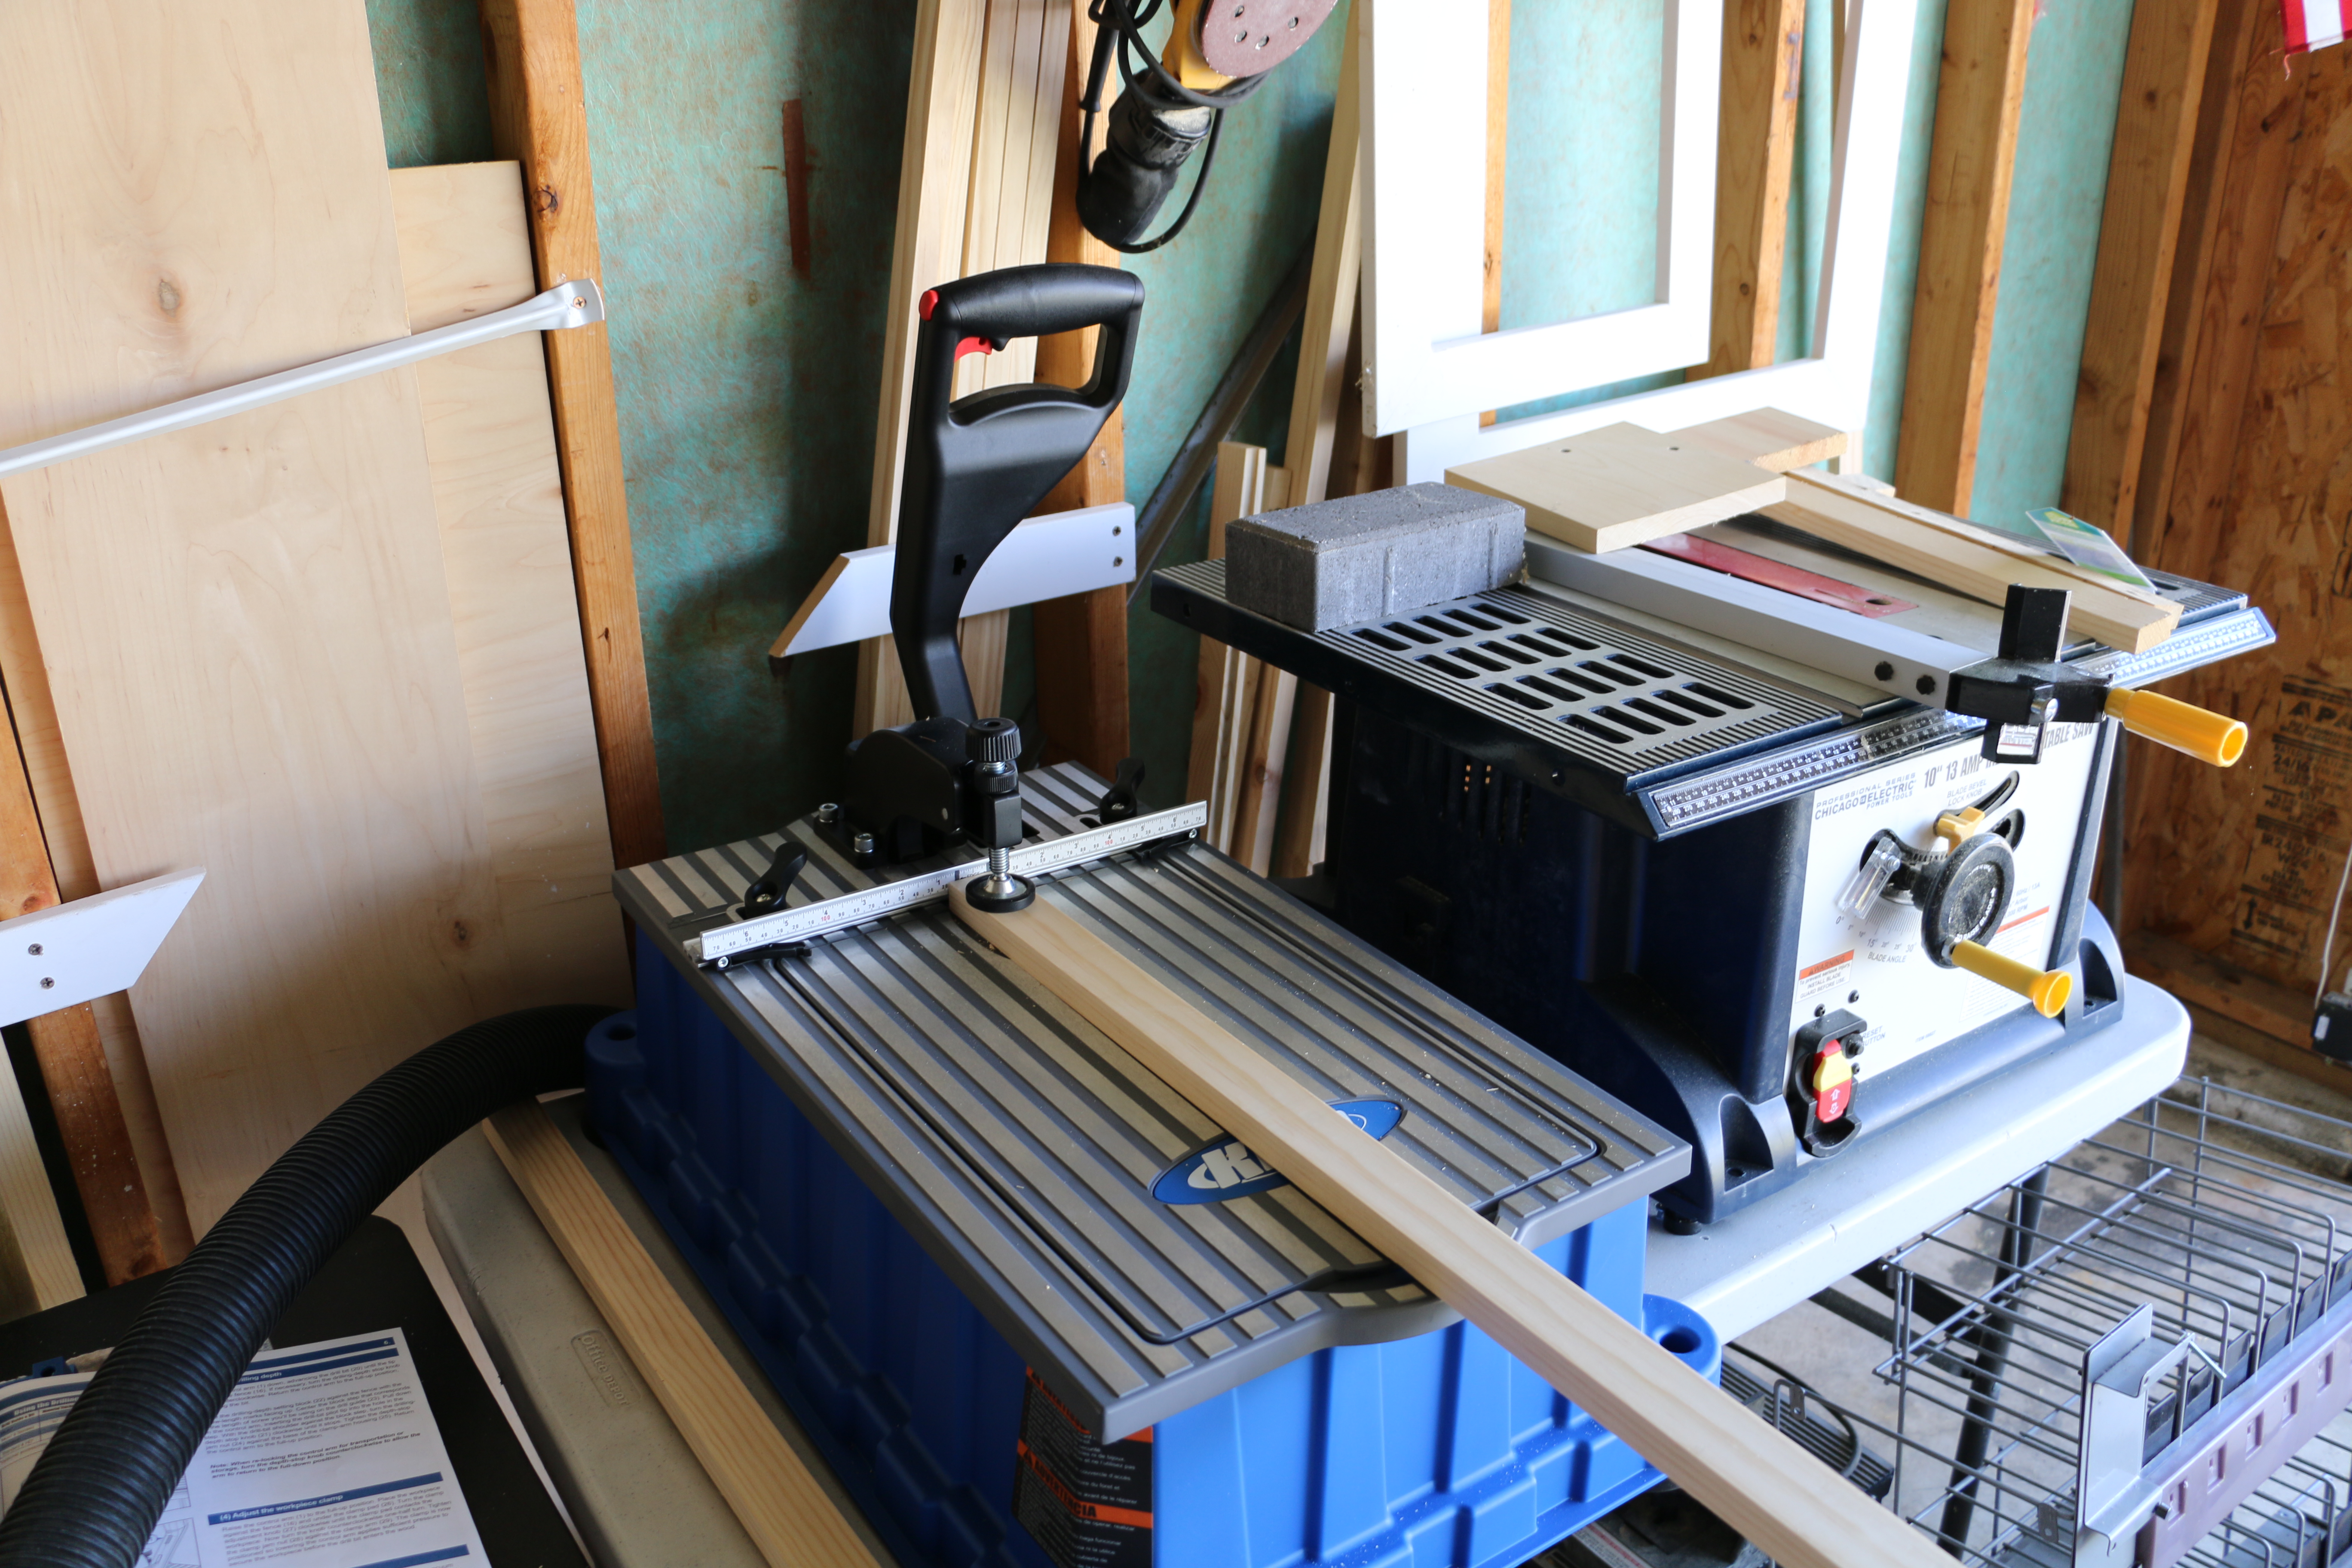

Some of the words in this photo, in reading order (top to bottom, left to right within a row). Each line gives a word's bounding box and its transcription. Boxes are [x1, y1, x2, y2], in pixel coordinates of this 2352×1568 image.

[2044, 723, 2071, 748] TABLE
[2072, 722, 2092, 740] SAW
[1946, 761, 1958, 781] 13
[1960, 754, 1983, 778] AMP
[1816, 782, 1881, 808] PROFESSIONAL
[1886, 772, 1916, 787] SERIES
[1947, 784, 1967, 798] BLADE
[1969, 779, 1987, 792] BEVEL
[1948, 795, 1965, 806] LOCK
[1966, 788, 1982, 800] KNOB
[1815, 798, 1861, 820] CHICAGO
[1867, 781, 1914, 803] ELECTRIC
[1866, 799, 1889, 810] POWER
[1893, 790, 1913, 804] TOOLS
[1963, 924, 1980, 940] RAISE
[1979, 898, 1995, 927] BLADE
[1814, 955, 1845, 972] WARNING
[1868, 952, 1886, 962] BLADE
[1805, 973, 1822, 984] prevent
[1822, 968, 1838, 977] serious
[1807, 978, 1825, 989] INSTALL
[1826, 971, 1841, 982] BLADE
[1800, 989, 1816, 999] GUARD
[1817, 980, 1835, 992] BEFORE
[1862, 1025, 1883, 1039] RESET
[581, 1335, 608, 1373] Office
[604, 1374, 628, 1406] DEPOT
[326, 1441, 382, 1455] counterclockwise
[350, 1433, 395, 1445] transportation
[233, 1510, 259, 1518] Adjust
[276, 1501, 316, 1510] workpiece
